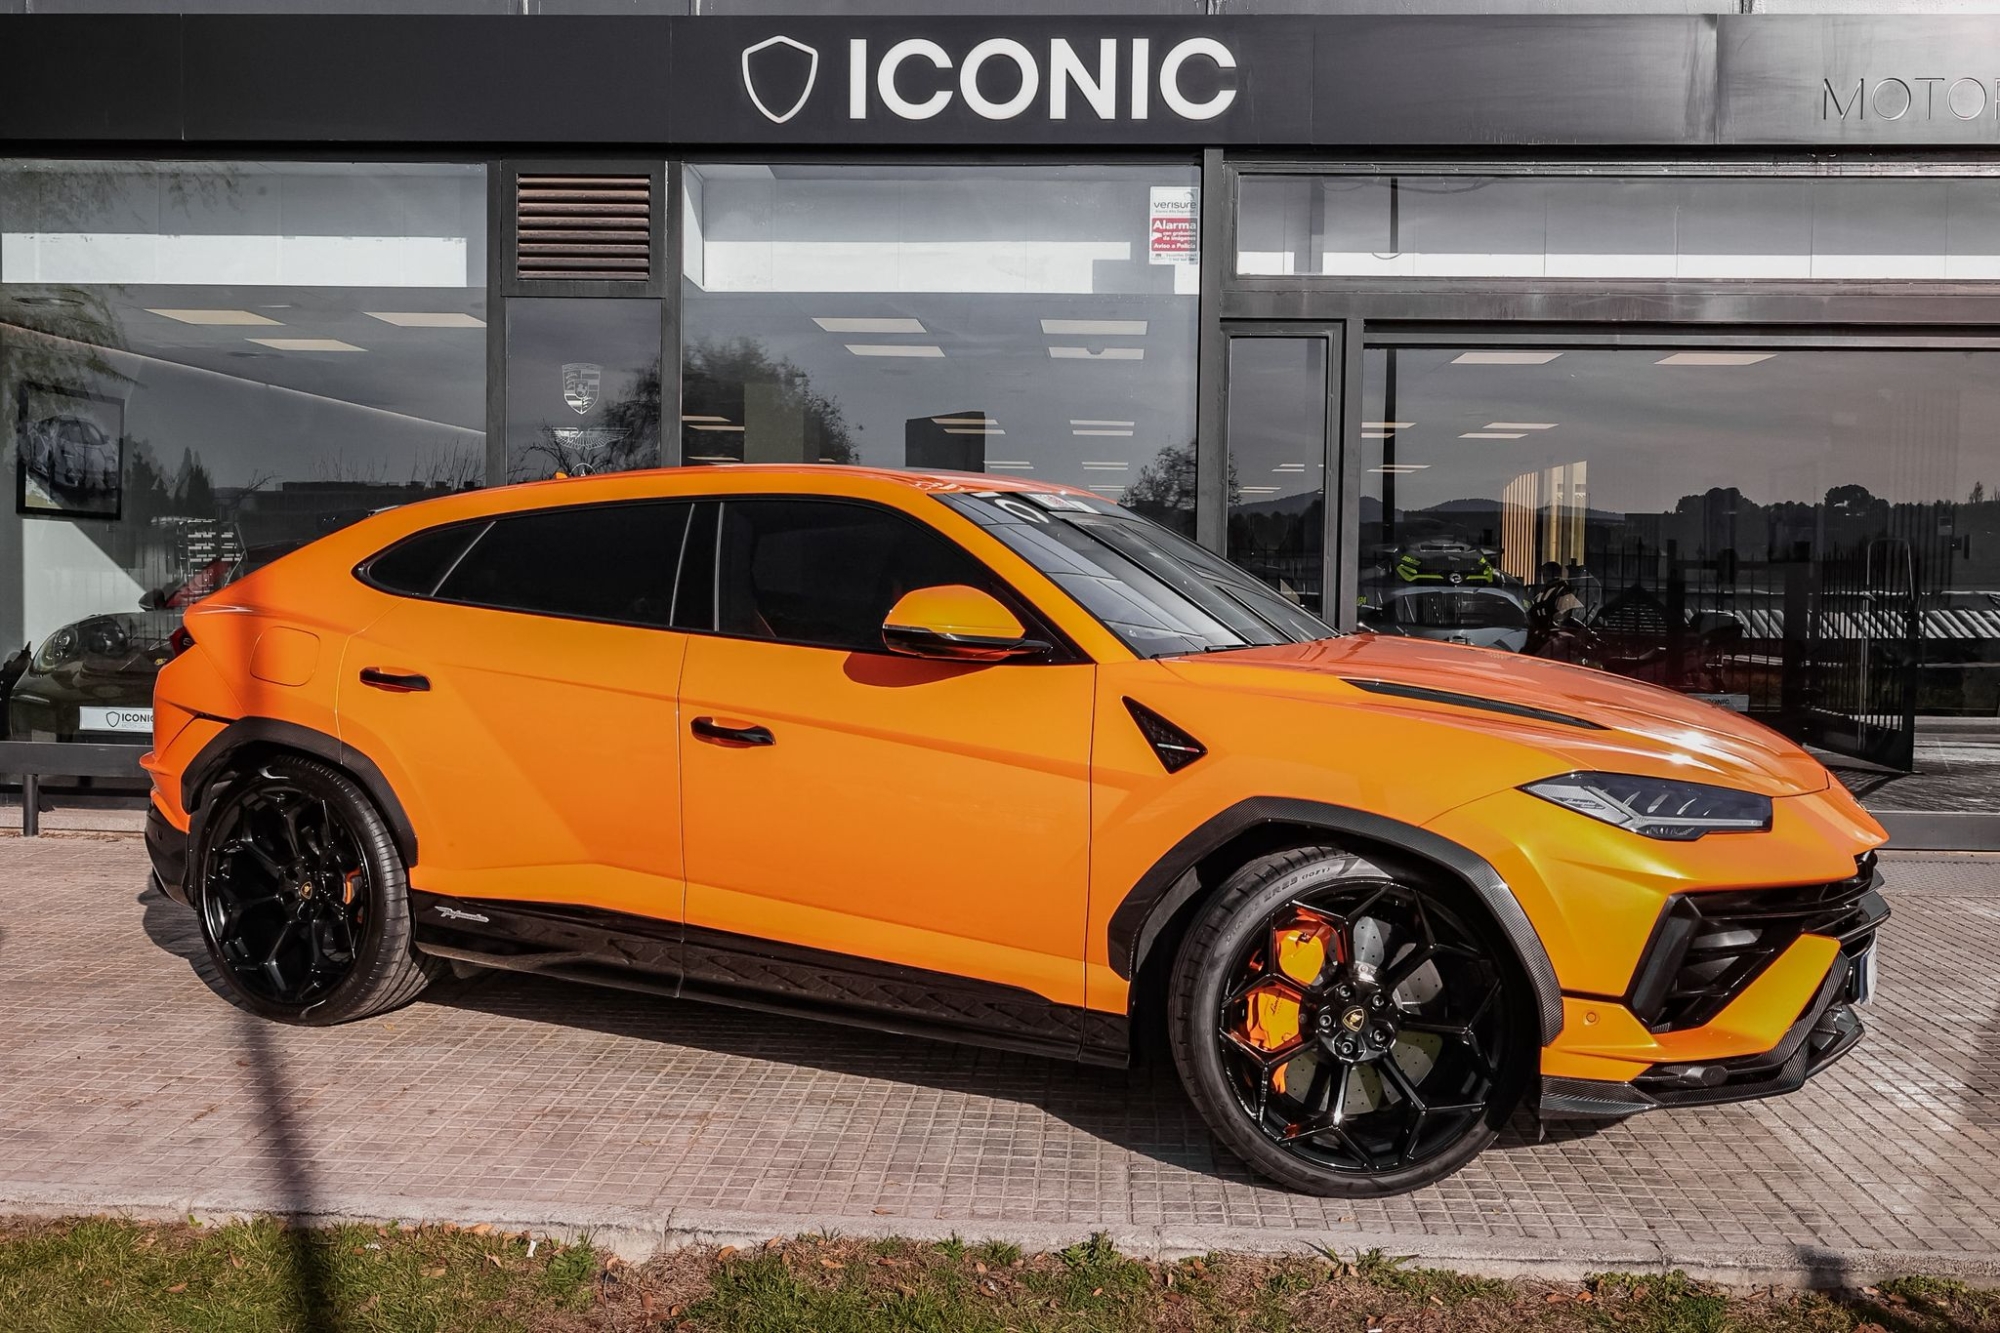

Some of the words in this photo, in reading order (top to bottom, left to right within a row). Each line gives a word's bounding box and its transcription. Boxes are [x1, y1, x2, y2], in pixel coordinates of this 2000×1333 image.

[850, 37, 1237, 120] ICONIC
[1153, 201, 1197, 209] verisure
[1153, 220, 1196, 229] Alarma
